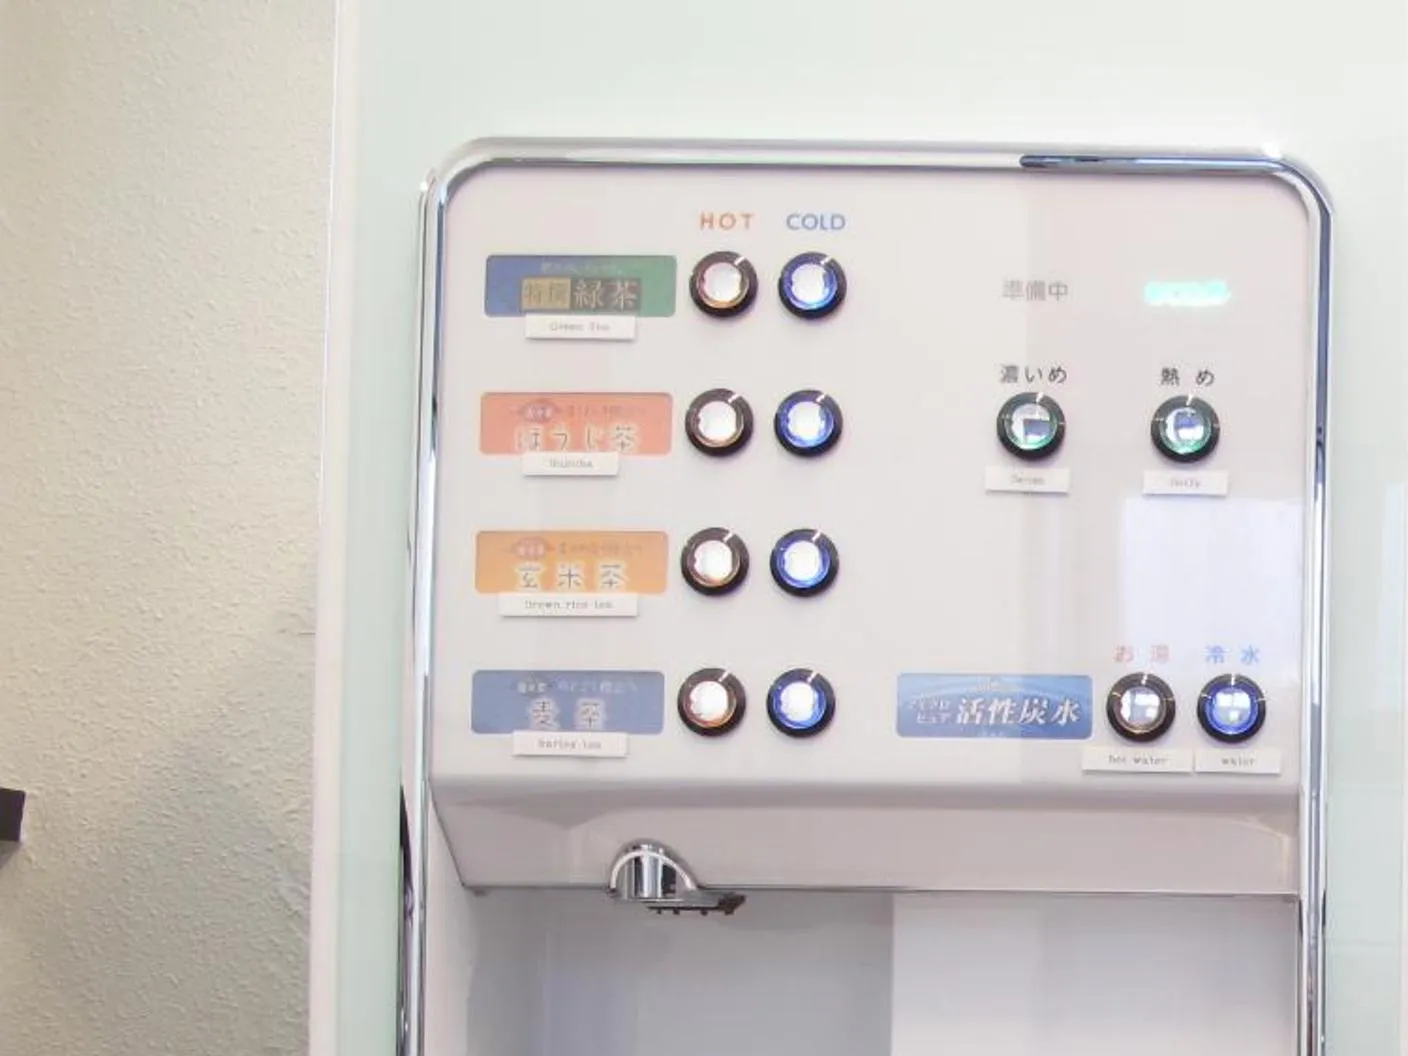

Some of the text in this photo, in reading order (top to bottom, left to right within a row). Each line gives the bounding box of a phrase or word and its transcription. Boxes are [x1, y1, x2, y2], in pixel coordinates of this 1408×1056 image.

[699, 212, 756, 230] HOT
[786, 213, 846, 231] COLD
[1002, 279, 1069, 301] 準備中
[999, 364, 1067, 384] 濃いめ
[1160, 367, 1214, 386] 熱め
[516, 424, 637, 452] ほうじ茶
[516, 564, 626, 590] 玄米茶
[1114, 644, 1171, 664] お湯
[1204, 644, 1261, 665] 冷水
[531, 701, 605, 729] 麦茶
[956, 697, 1081, 727] 活性炭水
